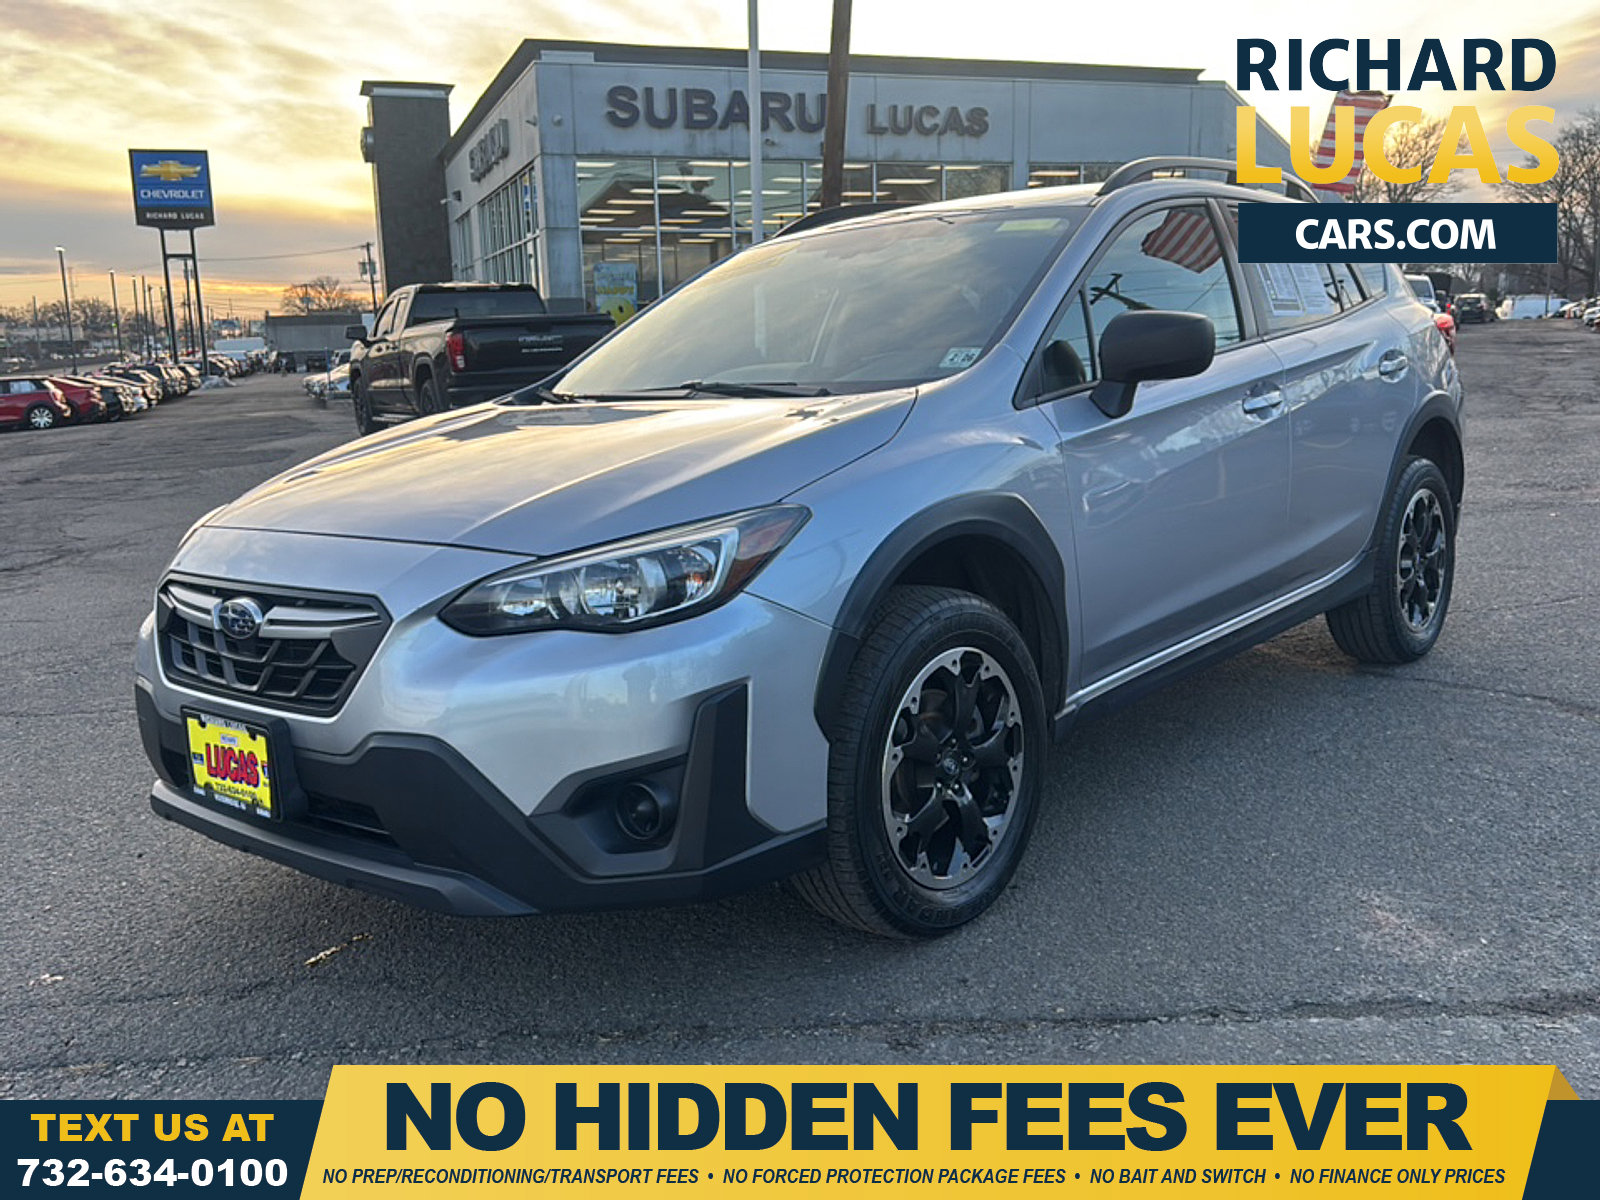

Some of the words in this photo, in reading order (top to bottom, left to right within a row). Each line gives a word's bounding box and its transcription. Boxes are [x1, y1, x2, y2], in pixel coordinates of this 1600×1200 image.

[605, 84, 827, 134] SUBARU
[866, 102, 990, 138] LUCAS
[140, 189, 205, 200] CHEVROLET
[146, 211, 178, 220] RICHARD
[181, 212, 205, 220] LUCAS
[205, 742, 260, 789] LUCAS
